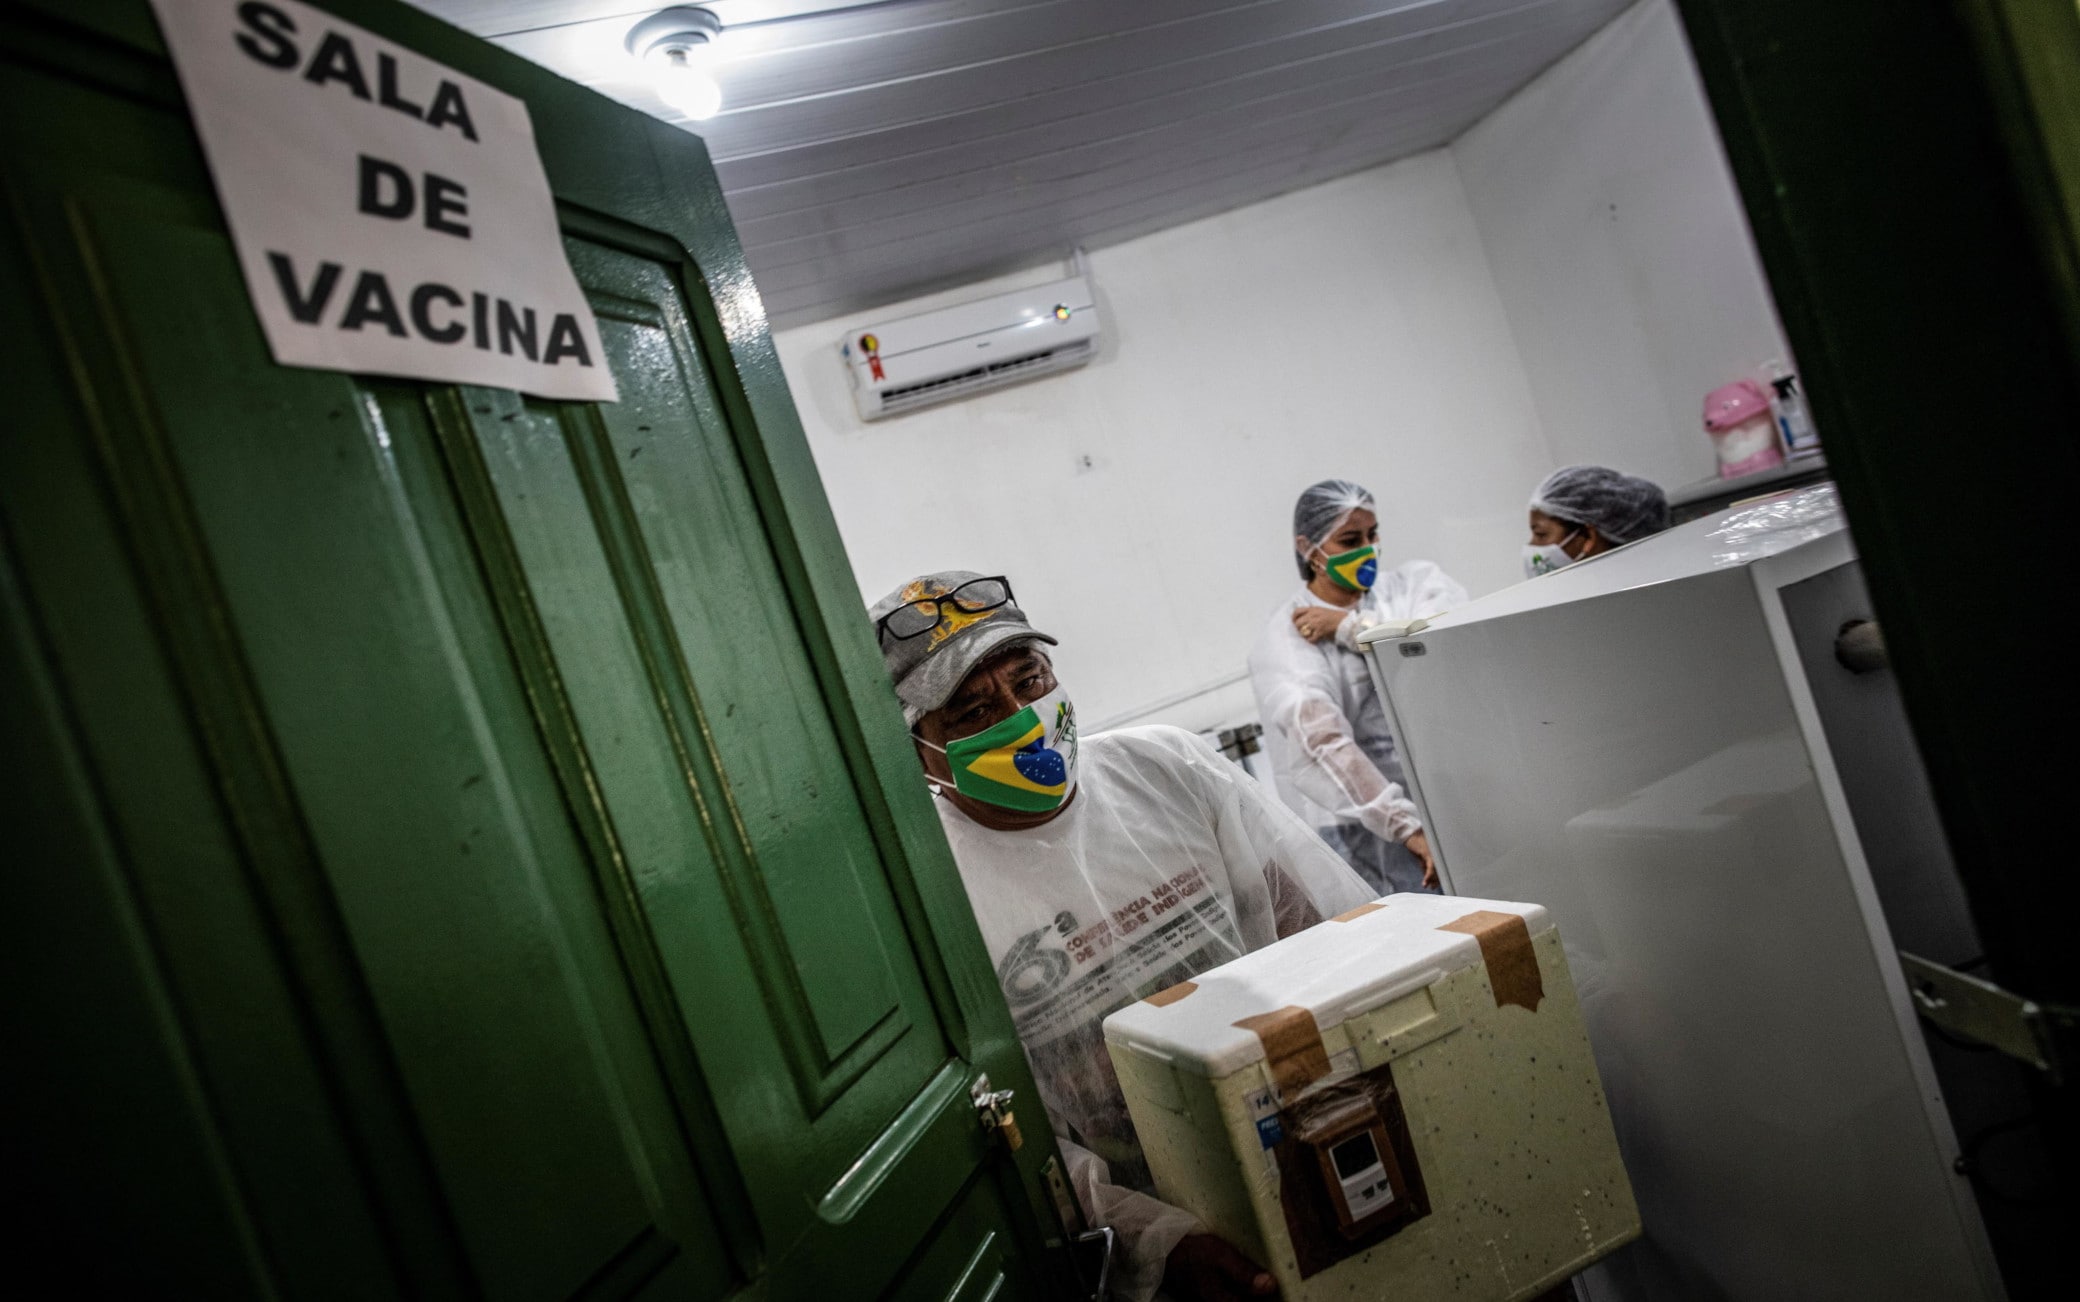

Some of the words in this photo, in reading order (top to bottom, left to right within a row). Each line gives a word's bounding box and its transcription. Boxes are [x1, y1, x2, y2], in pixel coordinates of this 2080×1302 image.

[233, 0, 480, 144] SALA
[357, 154, 473, 241] DE
[266, 250, 595, 368] VACINA
[1075, 945, 1097, 965] DE
